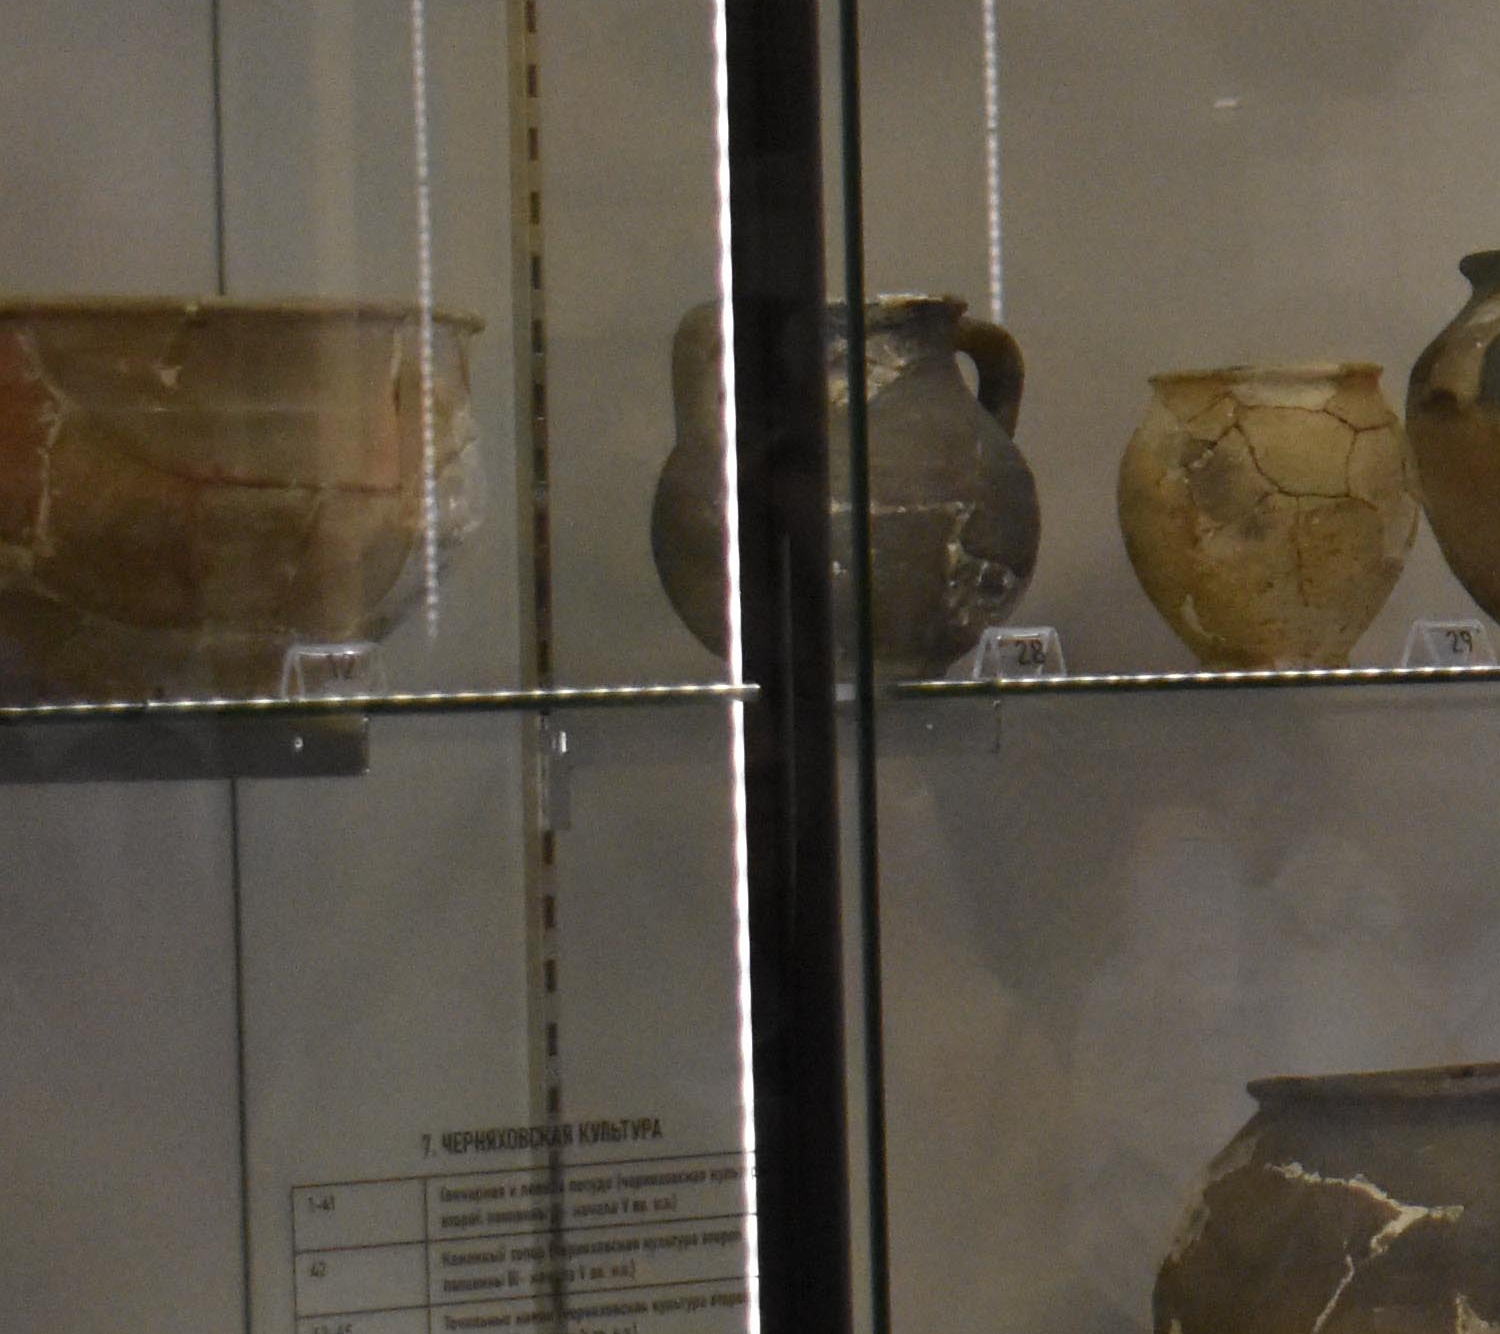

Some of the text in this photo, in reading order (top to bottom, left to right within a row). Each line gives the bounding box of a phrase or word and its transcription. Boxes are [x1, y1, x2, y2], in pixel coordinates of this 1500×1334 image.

[1016, 639, 1046, 665] 28
[1446, 630, 1473, 654] 29
[442, 1124, 573, 1155] ЧЕРНЯХОВСКАЯ
[578, 1117, 663, 1146] КУЛЬТУРА
